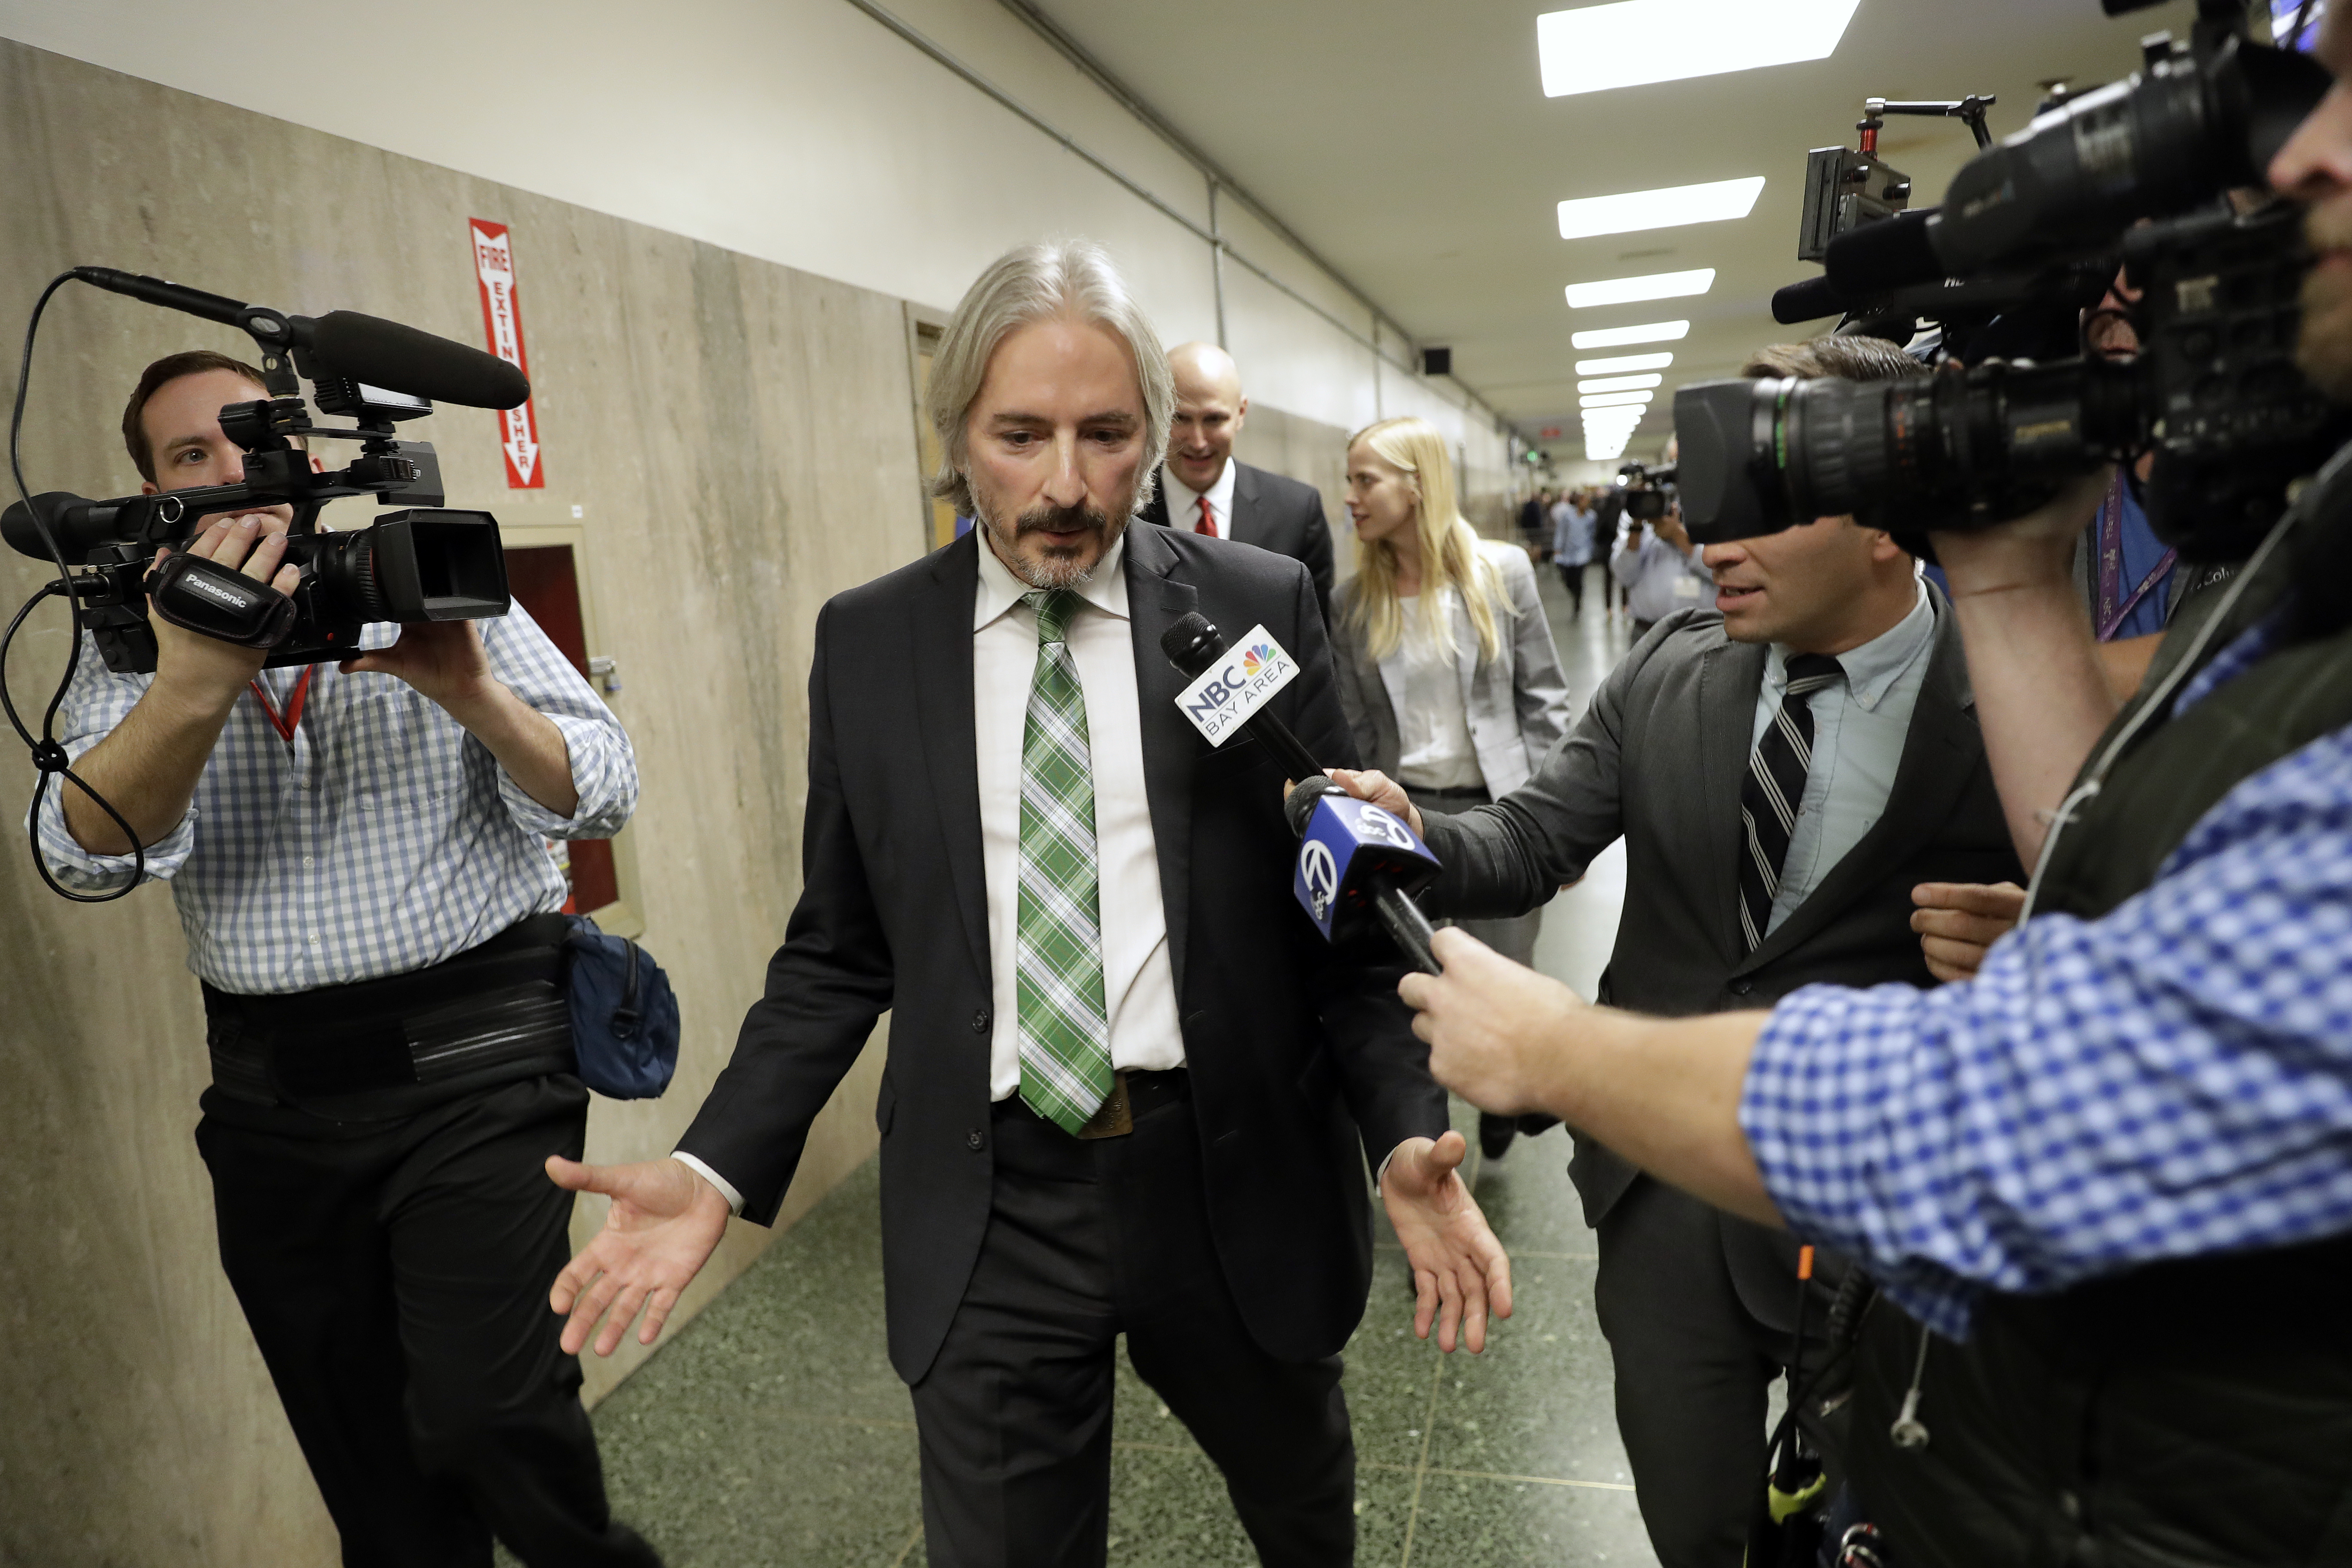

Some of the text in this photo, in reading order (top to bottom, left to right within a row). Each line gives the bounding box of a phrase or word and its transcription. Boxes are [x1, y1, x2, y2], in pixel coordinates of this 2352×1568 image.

[479, 245, 509, 272] FIRE
[493, 282, 530, 469] EXTINSHER
[185, 573, 247, 608] Panasonic
[1186, 665, 1246, 723] NBC
[1206, 660, 1290, 736] BAY AREA
